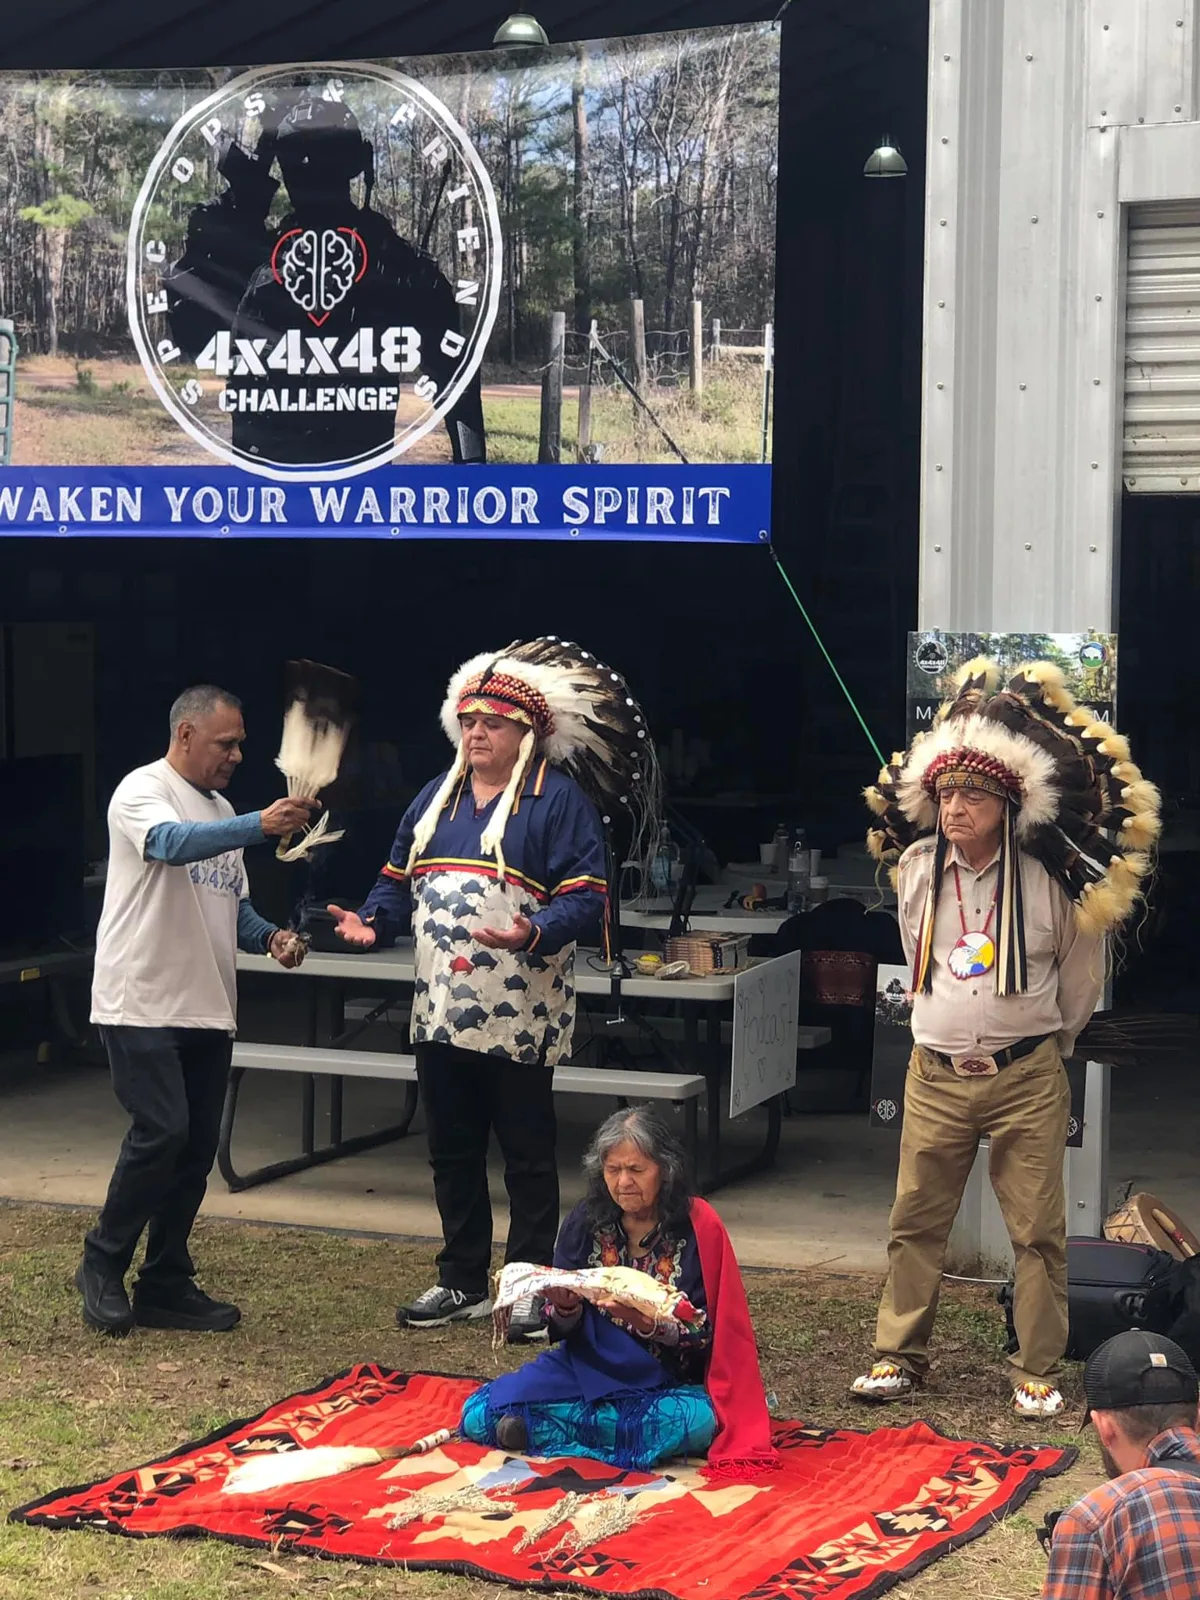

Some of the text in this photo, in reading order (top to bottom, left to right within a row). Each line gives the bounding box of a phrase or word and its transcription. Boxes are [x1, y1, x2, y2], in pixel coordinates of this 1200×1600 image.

[195, 325, 422, 376] 4x4x48
[218, 386, 398, 413] CHALLENGE
[0, 486, 731, 526] WAKEN YOUR WARRIOR SPIRIT
